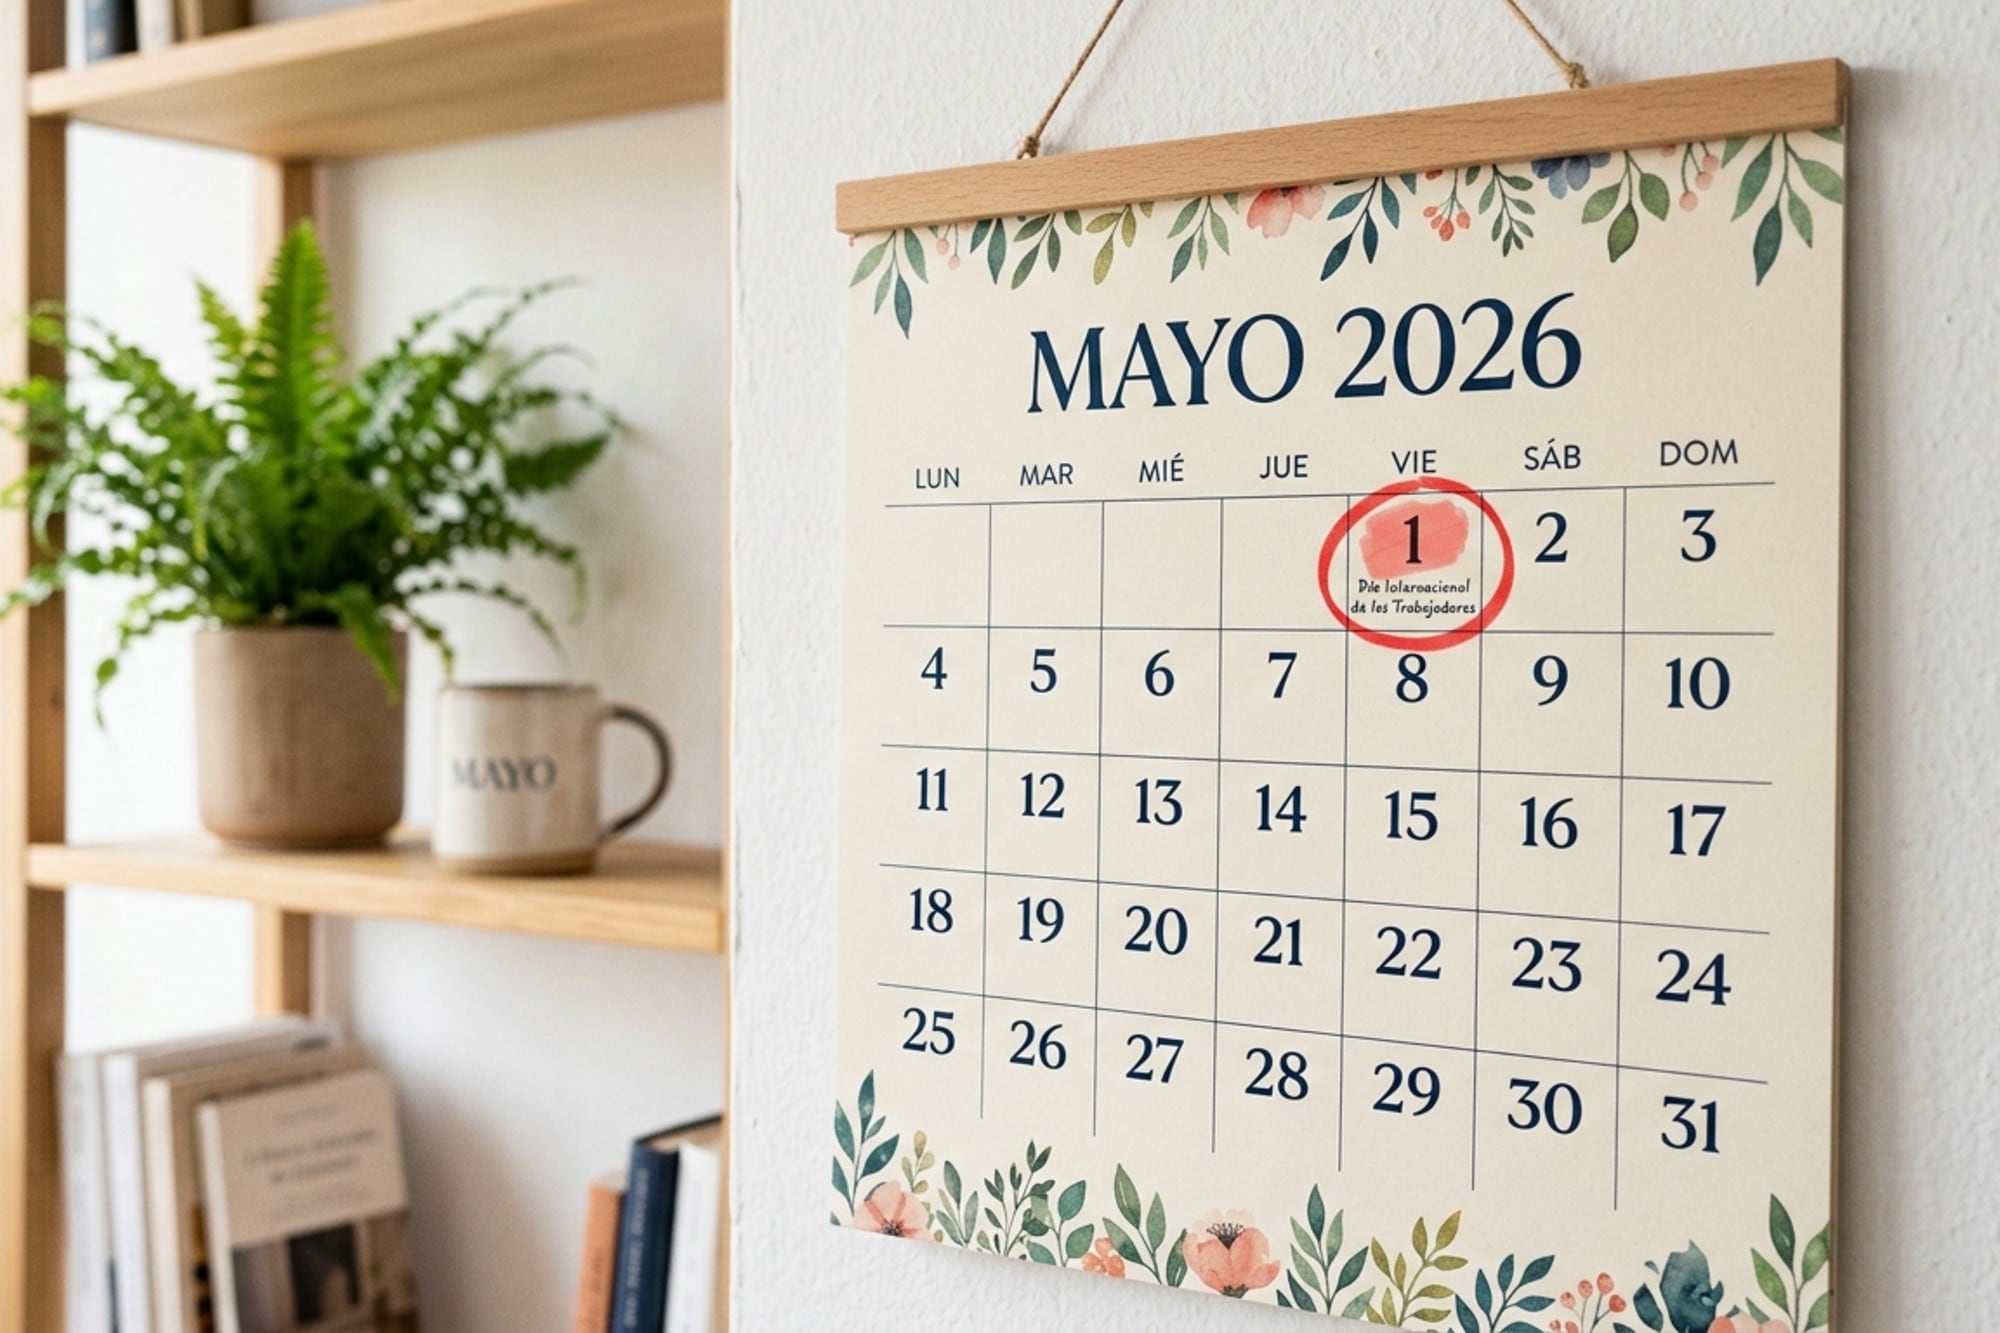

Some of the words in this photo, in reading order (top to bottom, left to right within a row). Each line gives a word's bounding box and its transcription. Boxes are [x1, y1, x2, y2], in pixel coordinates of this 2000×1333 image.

[1027, 314, 1306, 415] MAYO
[1334, 292, 1583, 399] 2026
[916, 467, 960, 490] LUN
[1020, 463, 1074, 486] MAR
[1139, 452, 1186, 483] MIÉ
[1259, 454, 1310, 480] JUE
[1390, 449, 1438, 475] VIE
[1524, 437, 1582, 472] SÁB
[1660, 439, 1739, 467] DOM
[1403, 514, 1423, 565] 1
[1534, 511, 1569, 563] 2
[1680, 509, 1718, 563] 3
[920, 646, 948, 690] 4
[1030, 648, 1057, 693] 5
[1144, 649, 1175, 697] 6
[1268, 651, 1298, 699] 7
[1395, 653, 1429, 703] 8
[1533, 655, 1569, 706] 9
[1665, 657, 1731, 711] 10
[451, 754, 558, 795] MAYO
[916, 767, 948, 812] 11
[1021, 772, 1065, 819] 12
[1135, 778, 1183, 826] 13
[1256, 784, 1307, 833] 14
[1385, 790, 1438, 841] 15
[1520, 796, 1578, 850] 16
[1667, 803, 1727, 857] 17
[910, 888, 954, 934] 18
[1017, 896, 1065, 944] 19
[1124, 905, 1188, 956] 20
[1253, 915, 1303, 967] 21
[1375, 926, 1442, 980] 22
[1511, 936, 1582, 993] 23
[1655, 948, 1732, 1006] 24
[902, 1007, 956, 1055] 25
[1009, 1020, 1067, 1070] 26
[1125, 1033, 1185, 1084] 27
[1244, 1047, 1309, 1101] 28
[1372, 1062, 1441, 1117] 29
[1507, 1077, 1583, 1135] 30
[1661, 1095, 1720, 1154] 31
